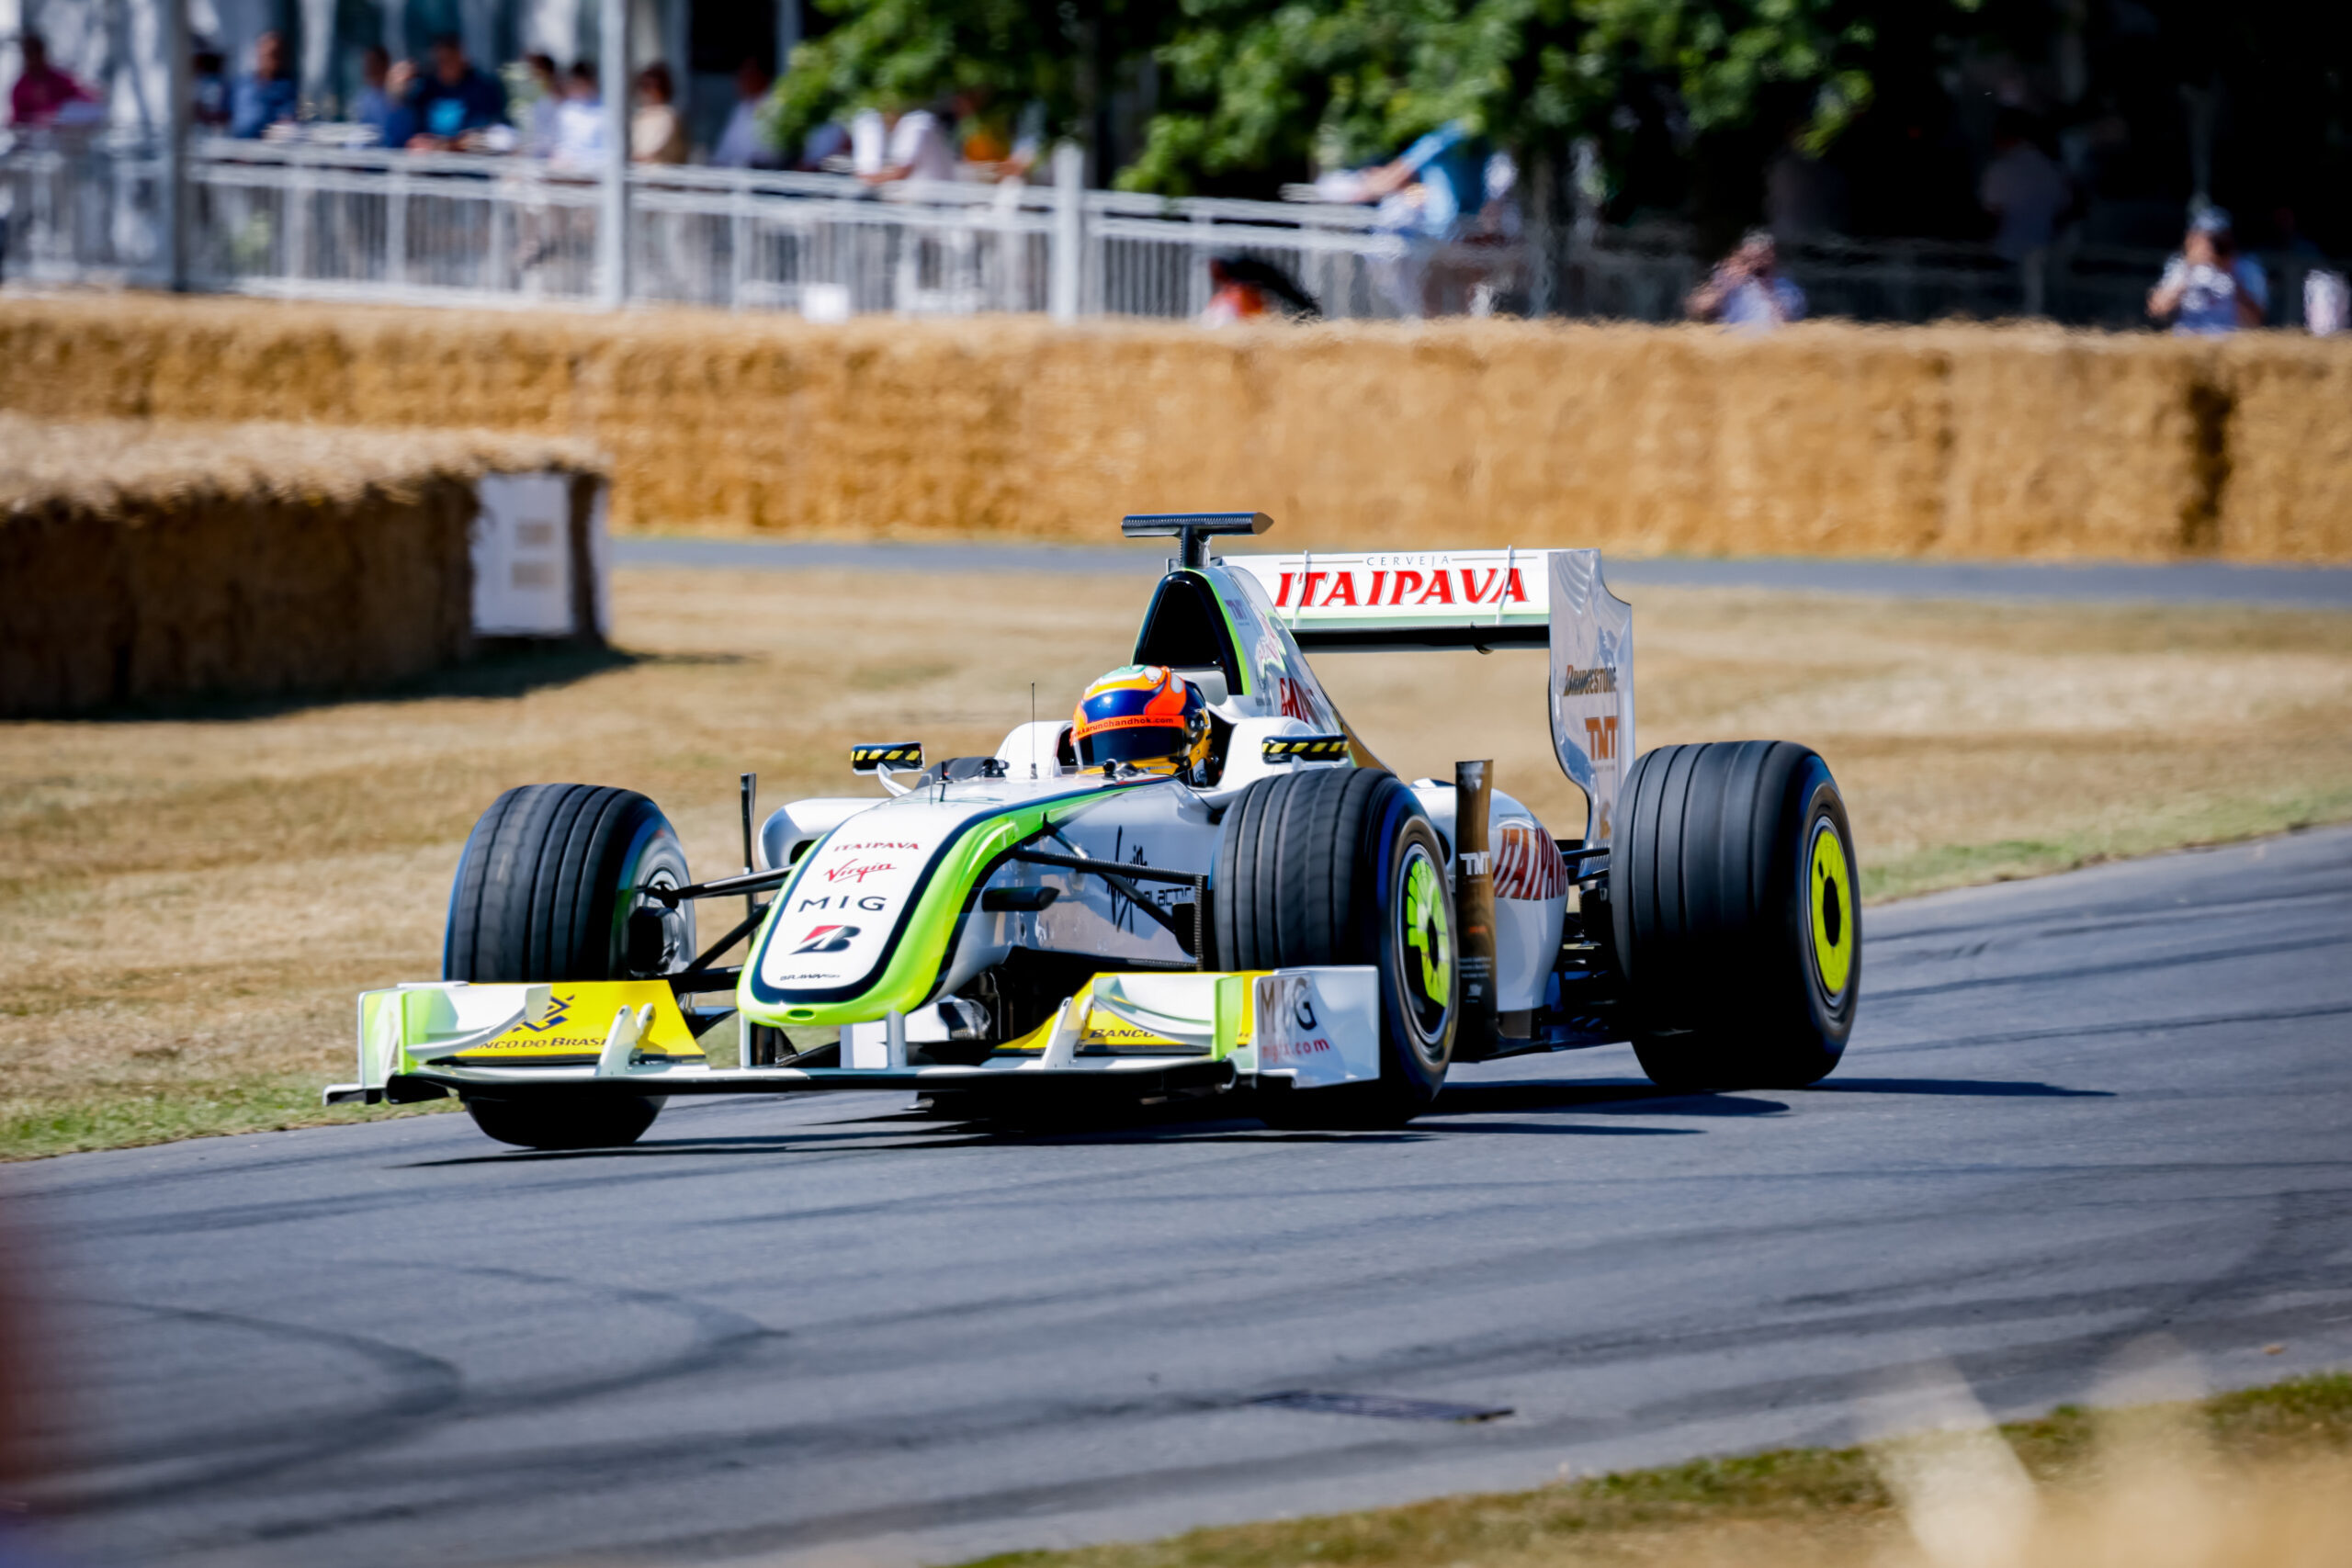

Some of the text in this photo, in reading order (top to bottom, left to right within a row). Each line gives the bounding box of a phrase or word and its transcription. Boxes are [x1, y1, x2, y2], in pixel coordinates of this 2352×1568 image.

[1367, 554, 1450, 568] CERVEJA
[1275, 568, 1530, 607] ITAIPAVA
[1585, 716, 1619, 761] TNT
[833, 841, 920, 852] ITAIPAVA
[823, 858, 897, 884] Virgin
[1459, 851, 1490, 876] TNT
[797, 895, 888, 913] MIG
[1261, 976, 1317, 1035] MIG
[522, 1039, 547, 1048] DO
